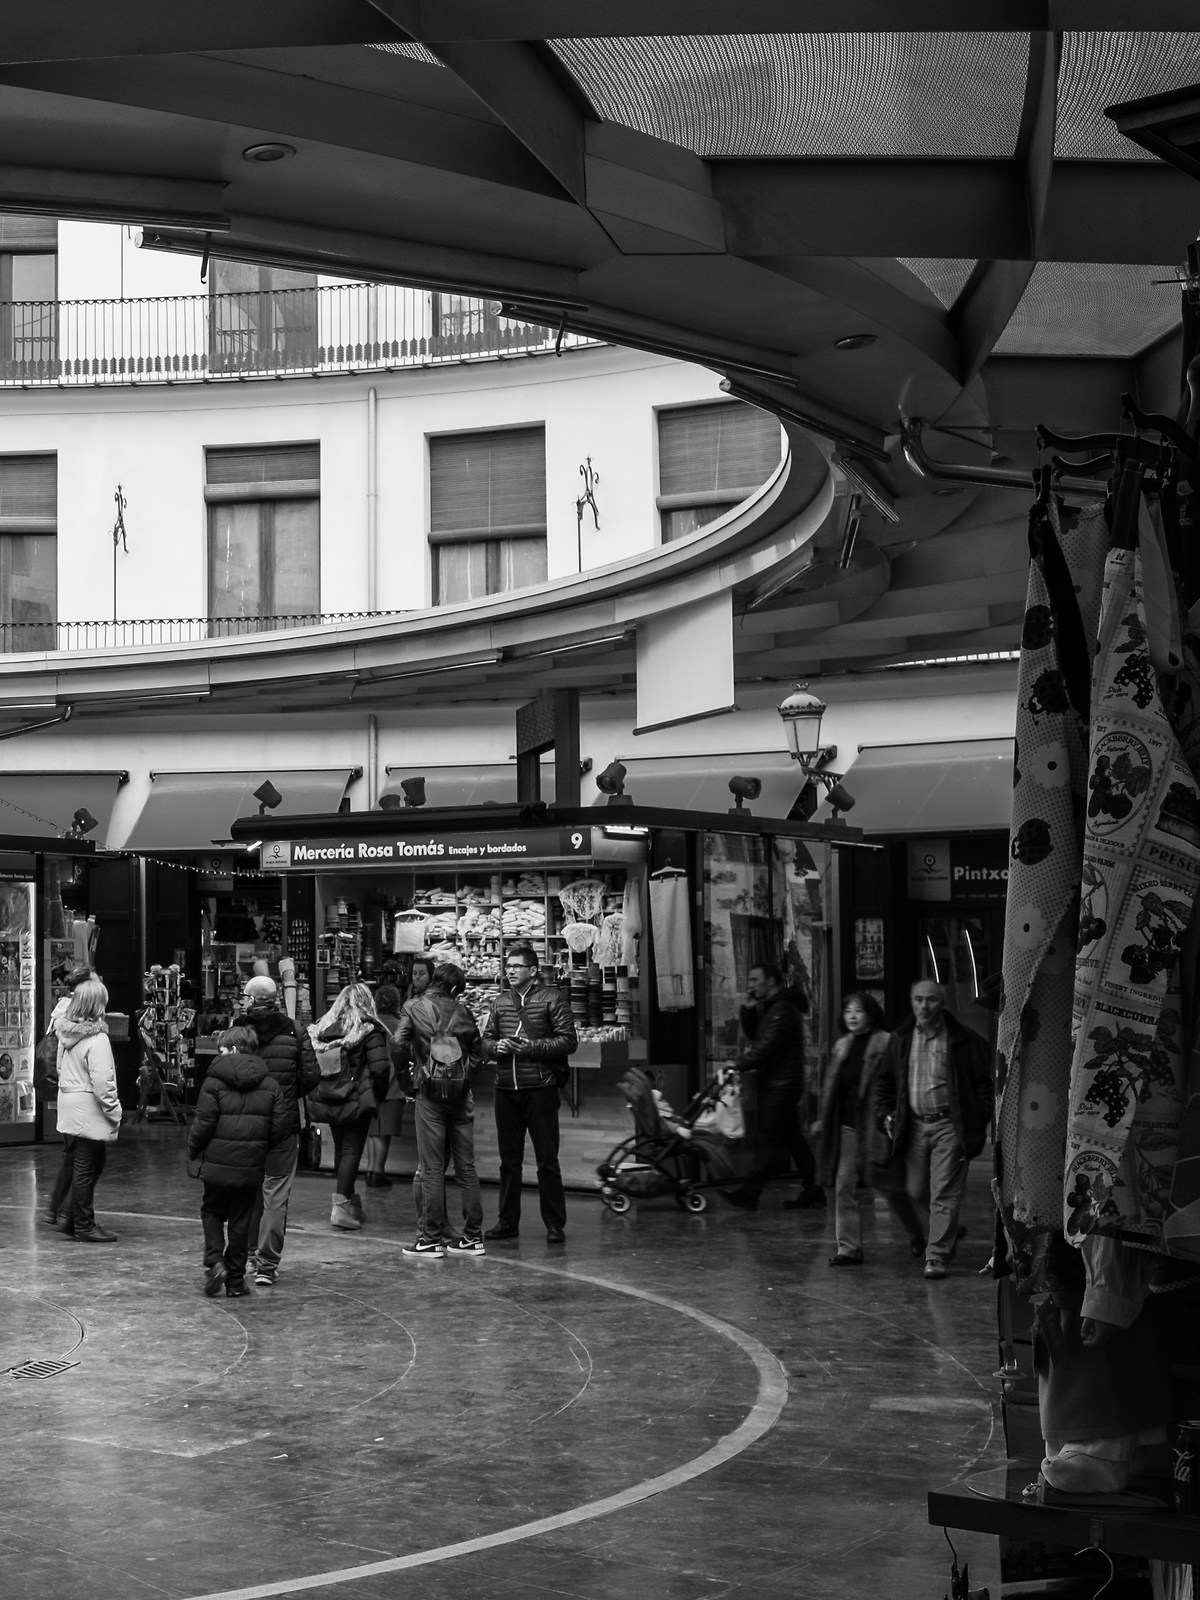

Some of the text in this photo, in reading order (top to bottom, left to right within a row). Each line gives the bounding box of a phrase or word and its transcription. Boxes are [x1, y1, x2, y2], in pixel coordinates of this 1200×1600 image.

[1096, 725, 1107, 733] EST
[1134, 745, 1150, 766] JELLY
[570, 832, 584, 850] 9
[1099, 838, 1125, 849] DELICIOUS
[294, 839, 527, 861] Mercería Rosa Tomás Encajes y bordados
[1132, 880, 1159, 893] MIXED
[1160, 880, 1183, 893] BERRY
[1104, 981, 1128, 993] FINEST
